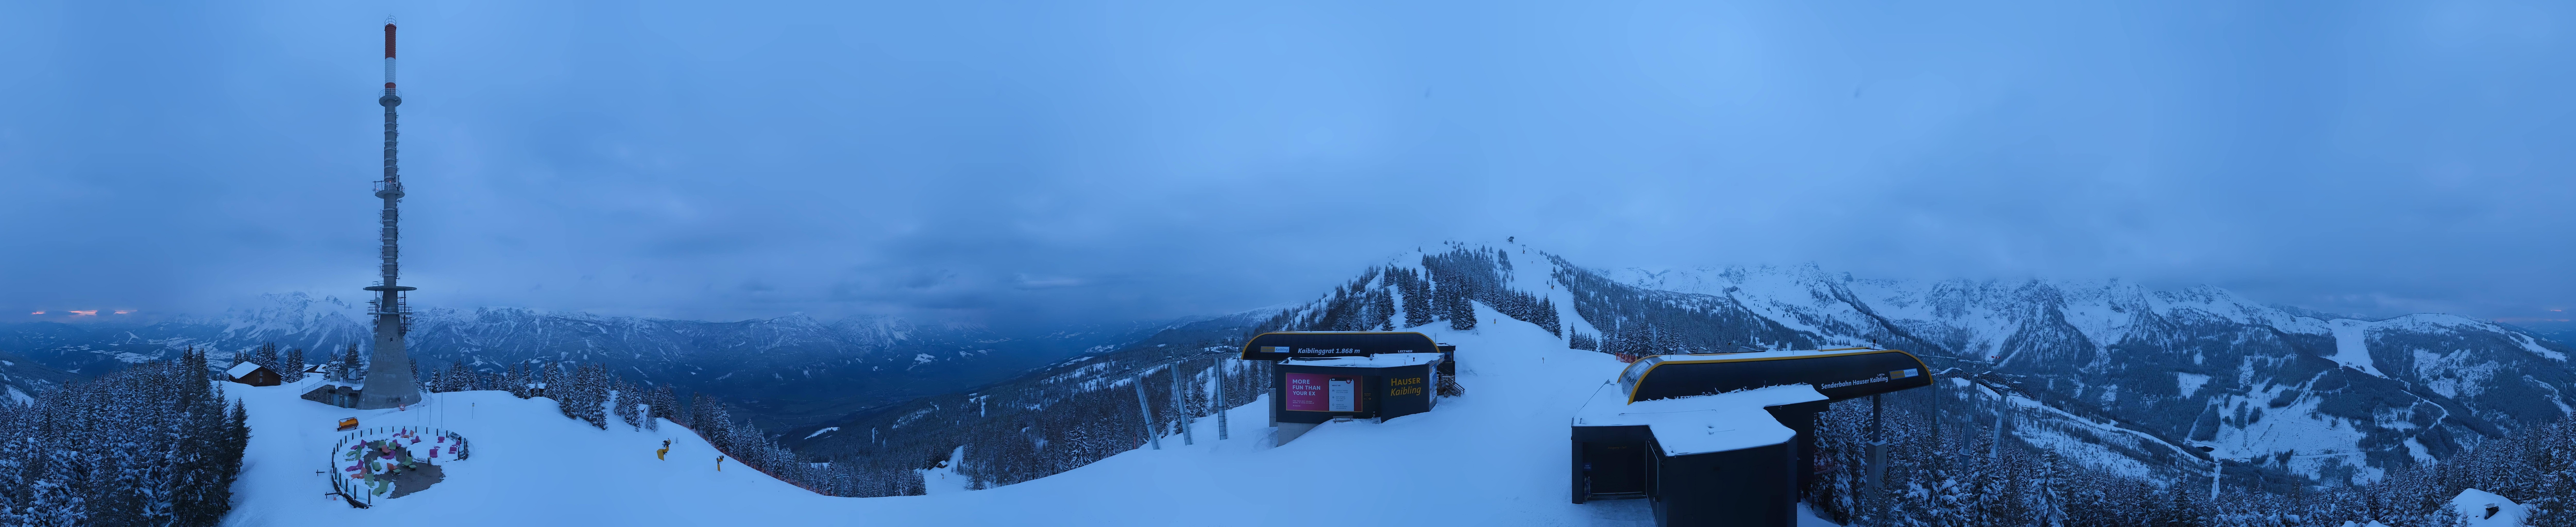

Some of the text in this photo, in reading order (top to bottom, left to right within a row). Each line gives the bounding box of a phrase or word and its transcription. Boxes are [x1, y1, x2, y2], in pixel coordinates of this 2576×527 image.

[1391, 378, 1421, 386] HAUSER
[1821, 380, 1852, 389] Senderbahn
[1391, 386, 1421, 396] Kaibling
